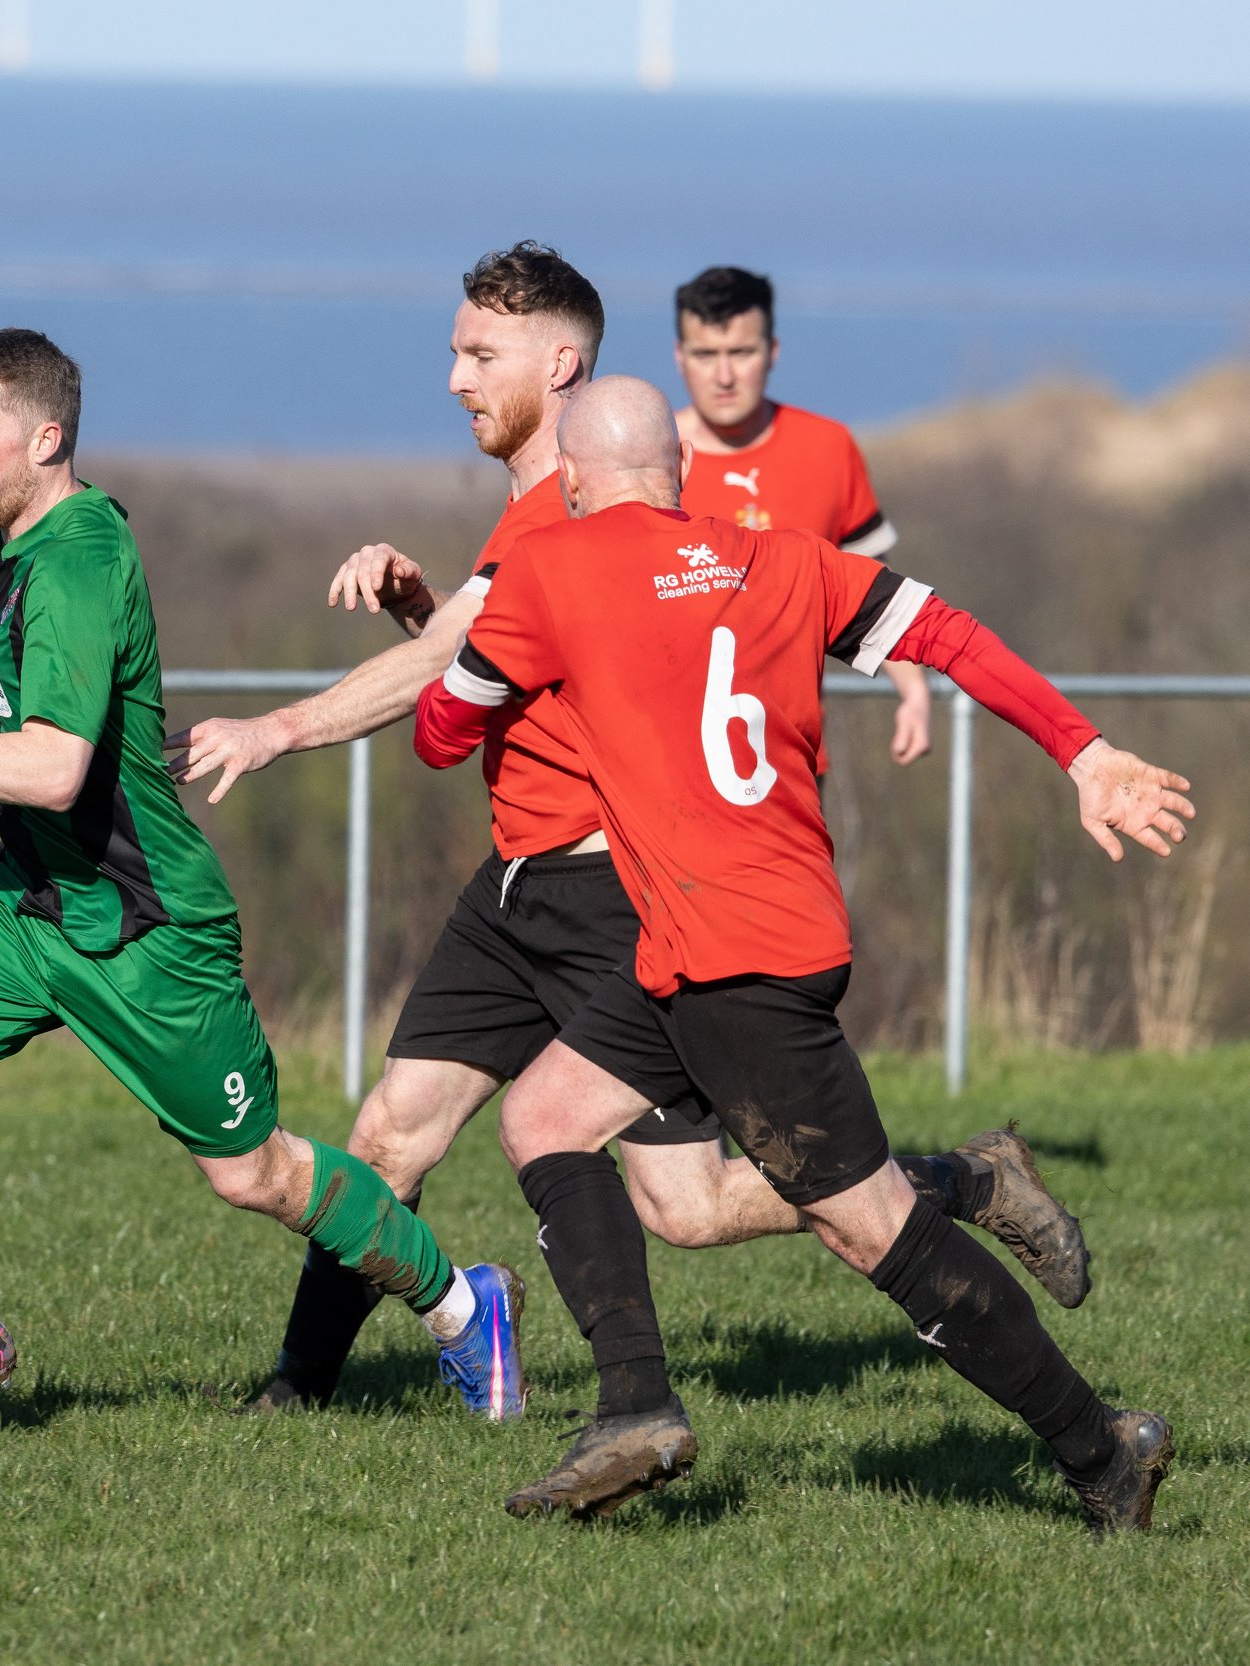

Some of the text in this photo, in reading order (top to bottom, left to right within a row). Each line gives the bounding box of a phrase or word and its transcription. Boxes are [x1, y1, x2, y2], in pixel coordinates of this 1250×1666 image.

[653, 574, 679, 589] RG
[657, 582, 710, 600] cleaning
[701, 625, 778, 806] 6
[223, 1071, 245, 1105] 9
